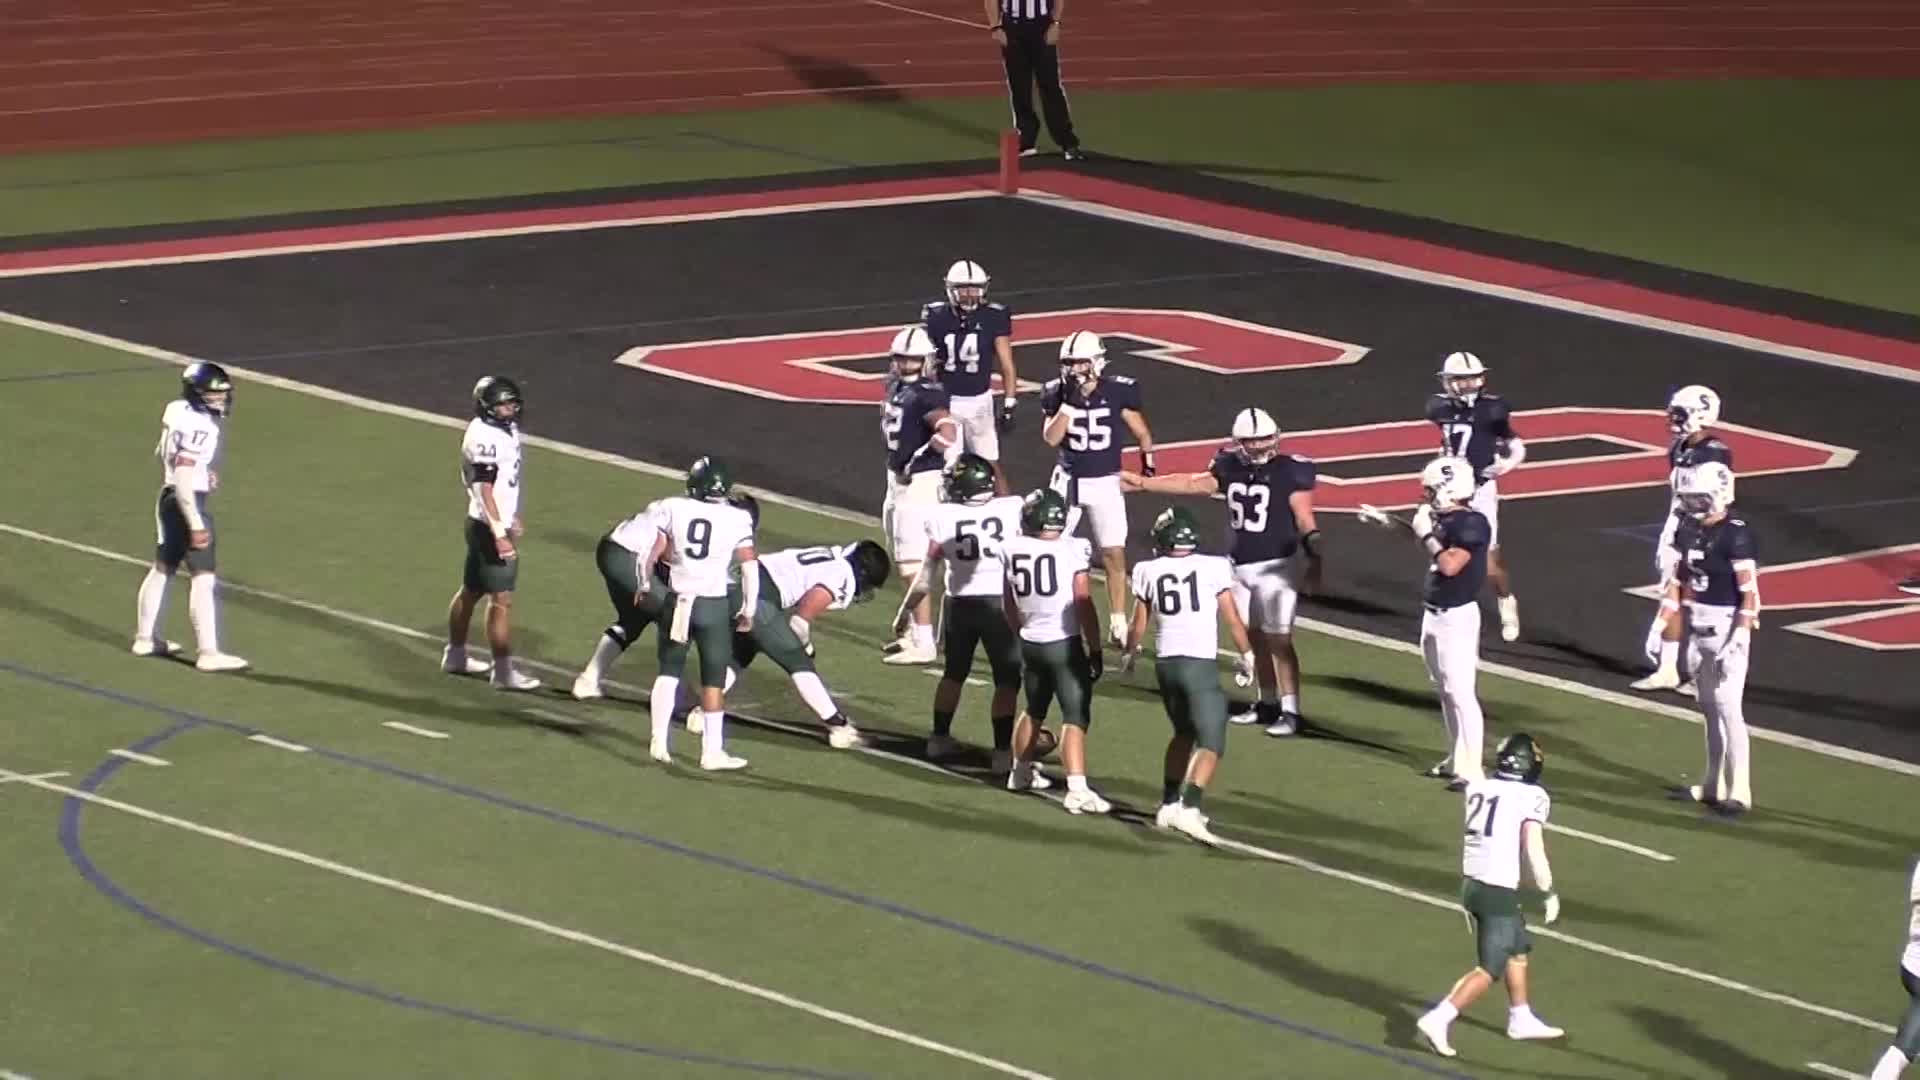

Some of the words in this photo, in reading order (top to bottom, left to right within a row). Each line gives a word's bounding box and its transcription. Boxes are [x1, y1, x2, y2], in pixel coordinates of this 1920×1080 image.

[944, 333, 981, 373] 14
[1699, 394, 1711, 411] S
[1068, 408, 1112, 451] 55
[1227, 482, 1270, 532] 63
[684, 518, 712, 560] 9
[955, 516, 1004, 561] 53
[1011, 553, 1058, 597] 50
[1157, 570, 1200, 616] 61
[1466, 793, 1500, 837] 21
